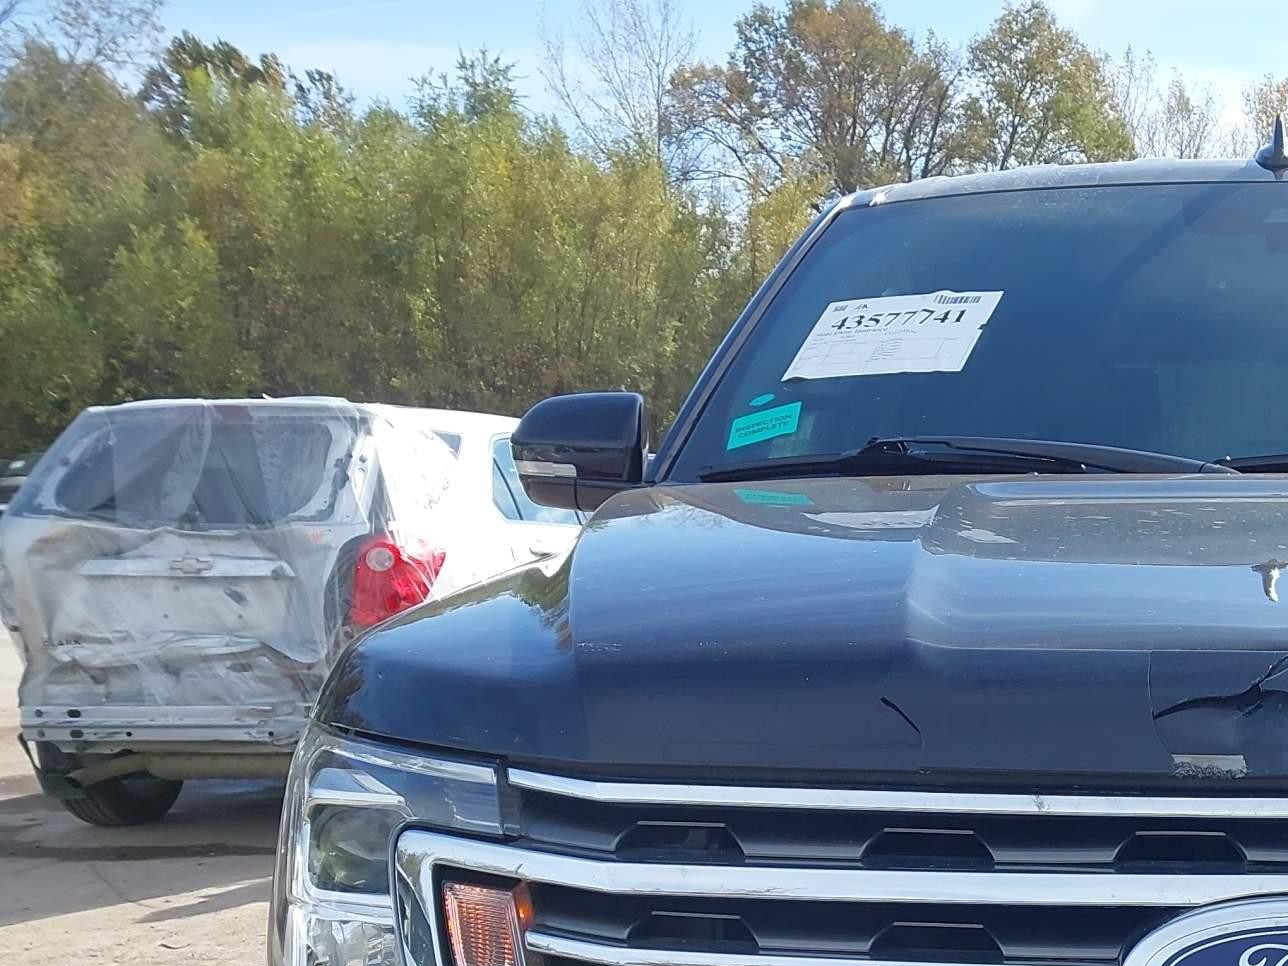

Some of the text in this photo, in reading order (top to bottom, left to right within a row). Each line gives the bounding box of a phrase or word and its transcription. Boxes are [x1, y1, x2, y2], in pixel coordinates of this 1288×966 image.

[831, 308, 967, 331] 43577741
[734, 414, 793, 433] INSPECTION
[737, 421, 789, 439] COMPLETE
